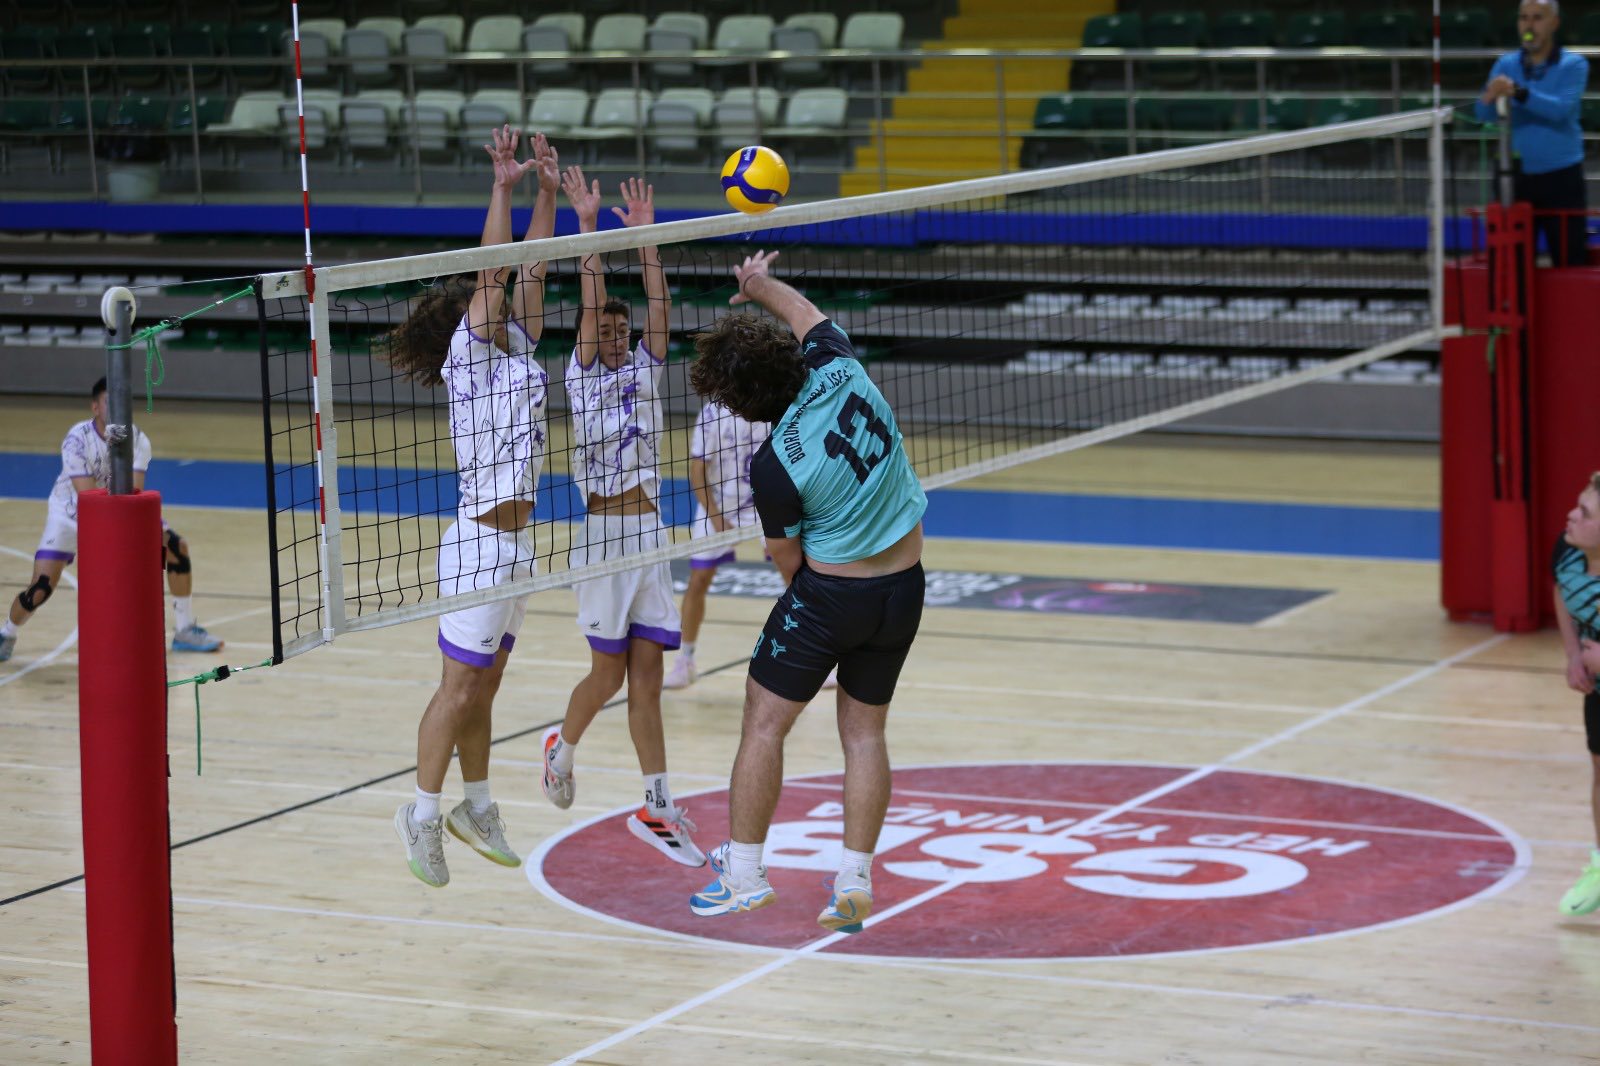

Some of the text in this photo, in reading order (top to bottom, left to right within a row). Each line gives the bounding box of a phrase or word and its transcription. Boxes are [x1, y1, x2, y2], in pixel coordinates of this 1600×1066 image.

[783, 420, 806, 465] BODRUM
[823, 391, 893, 485] 13
[1189, 831, 1370, 857] HEP
